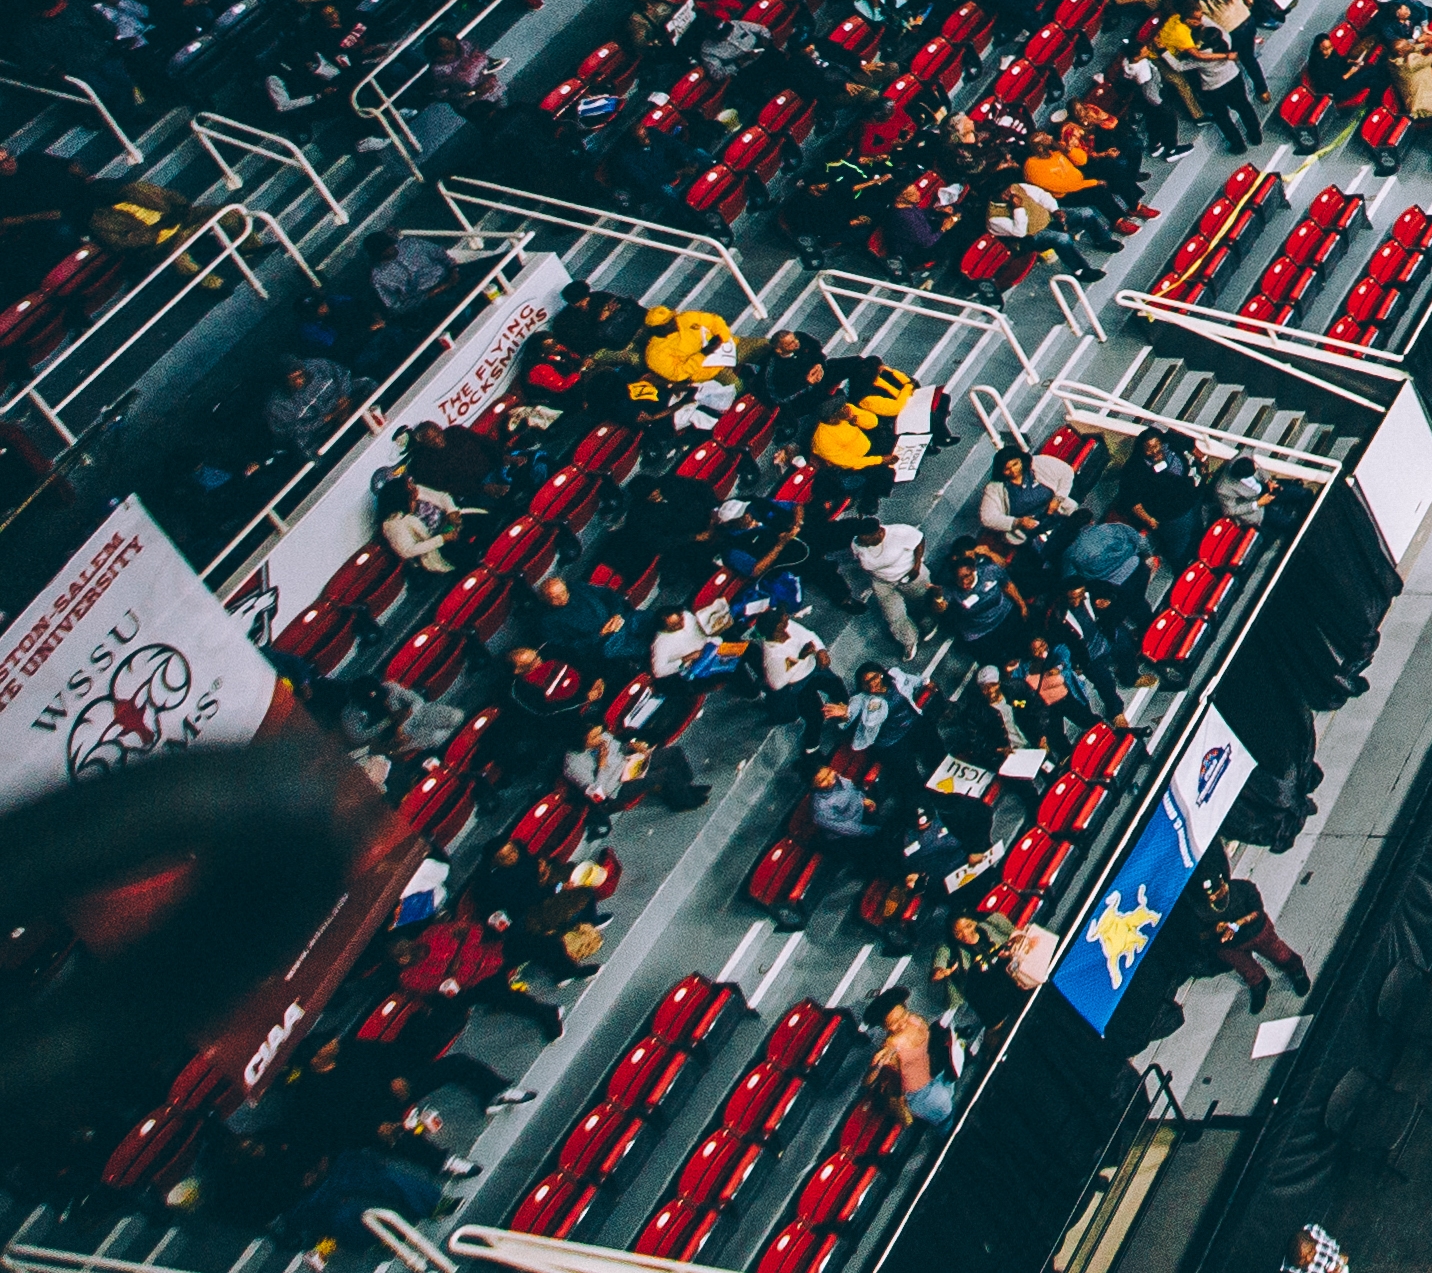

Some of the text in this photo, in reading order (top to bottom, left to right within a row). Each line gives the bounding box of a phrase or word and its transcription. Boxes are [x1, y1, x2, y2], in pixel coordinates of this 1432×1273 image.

[438, 304, 536, 414] THE FLYING
[446, 307, 548, 427] LOCKSMITHS
[22, 534, 144, 675] UNIVERSITY
[31, 607, 142, 736] WSSU
